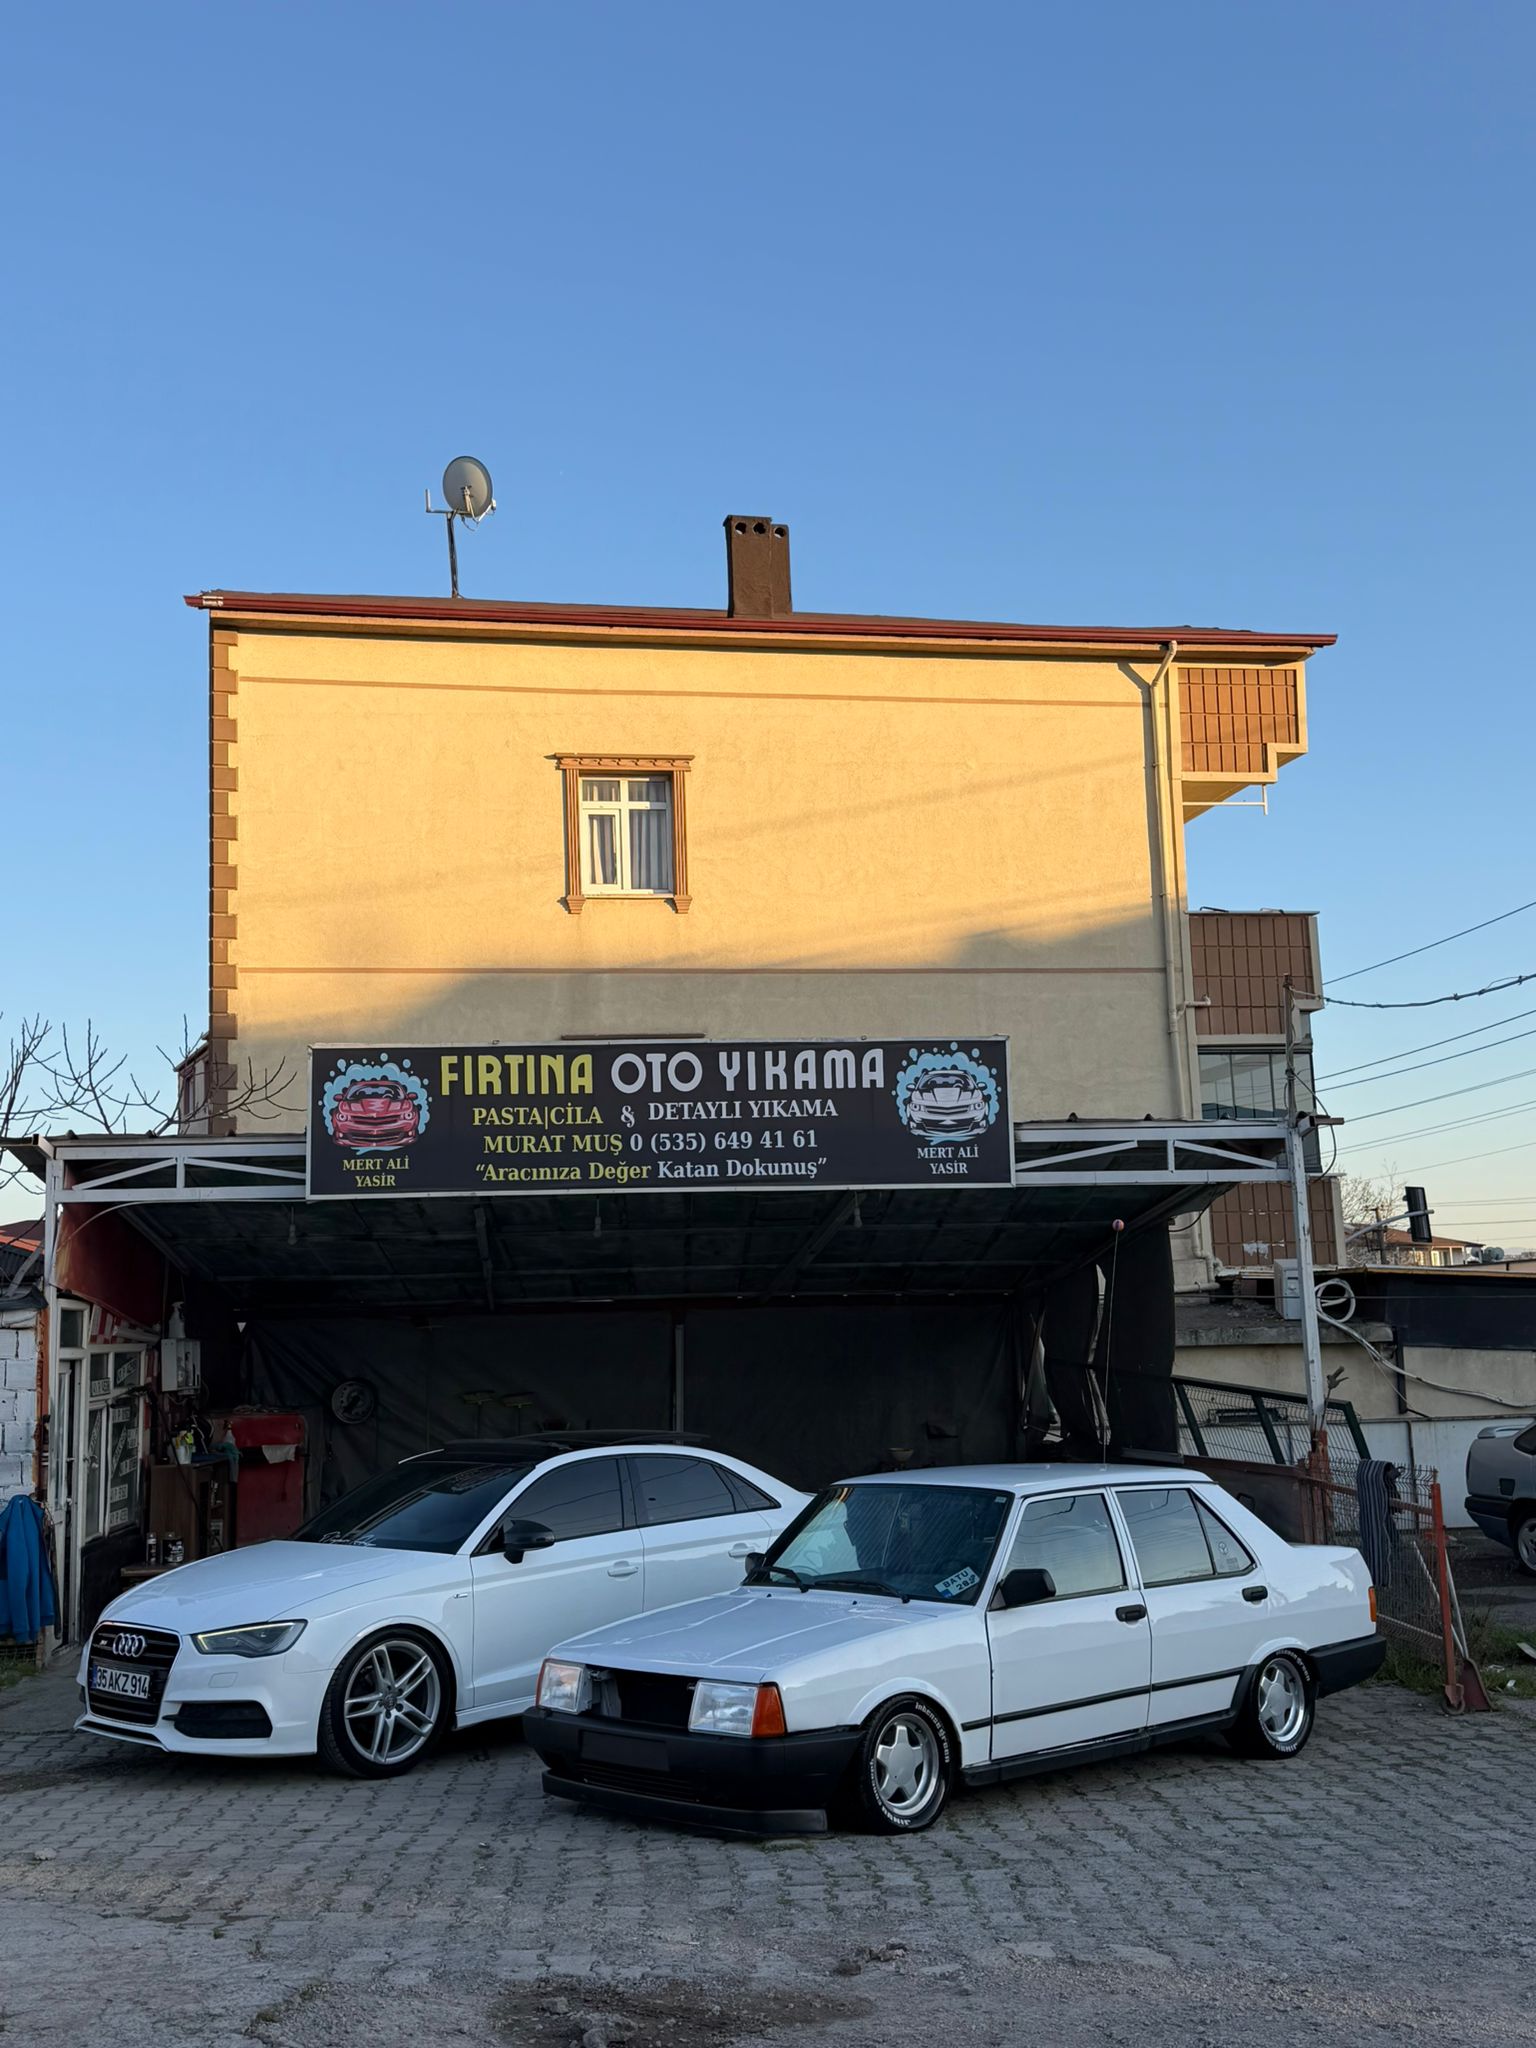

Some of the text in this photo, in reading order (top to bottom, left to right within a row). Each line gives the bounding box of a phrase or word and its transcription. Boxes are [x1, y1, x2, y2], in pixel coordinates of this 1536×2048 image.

[441, 1048, 884, 1096] FIRTINA OTO YIKAMA
[621, 1105, 636, 1128] &
[648, 1100, 742, 1121] DETAYLI
[750, 1098, 839, 1119] YIKAMA
[484, 1129, 819, 1156] MURAT MUŞ 0 (535) 649 41 61
[917, 1143, 979, 1160] MERT ALİ
[342, 1155, 410, 1172] MERT ALİ
[588, 1162, 652, 1184] Değer
[657, 1161, 720, 1180] Katan
[726, 1157, 828, 1178] Dokunuş”
[929, 1159, 968, 1175] YASİR
[355, 1172, 396, 1188] YASİR
[942, 1570, 969, 1588] BATU
[96, 1667, 148, 1697] 35 AKZ 914
